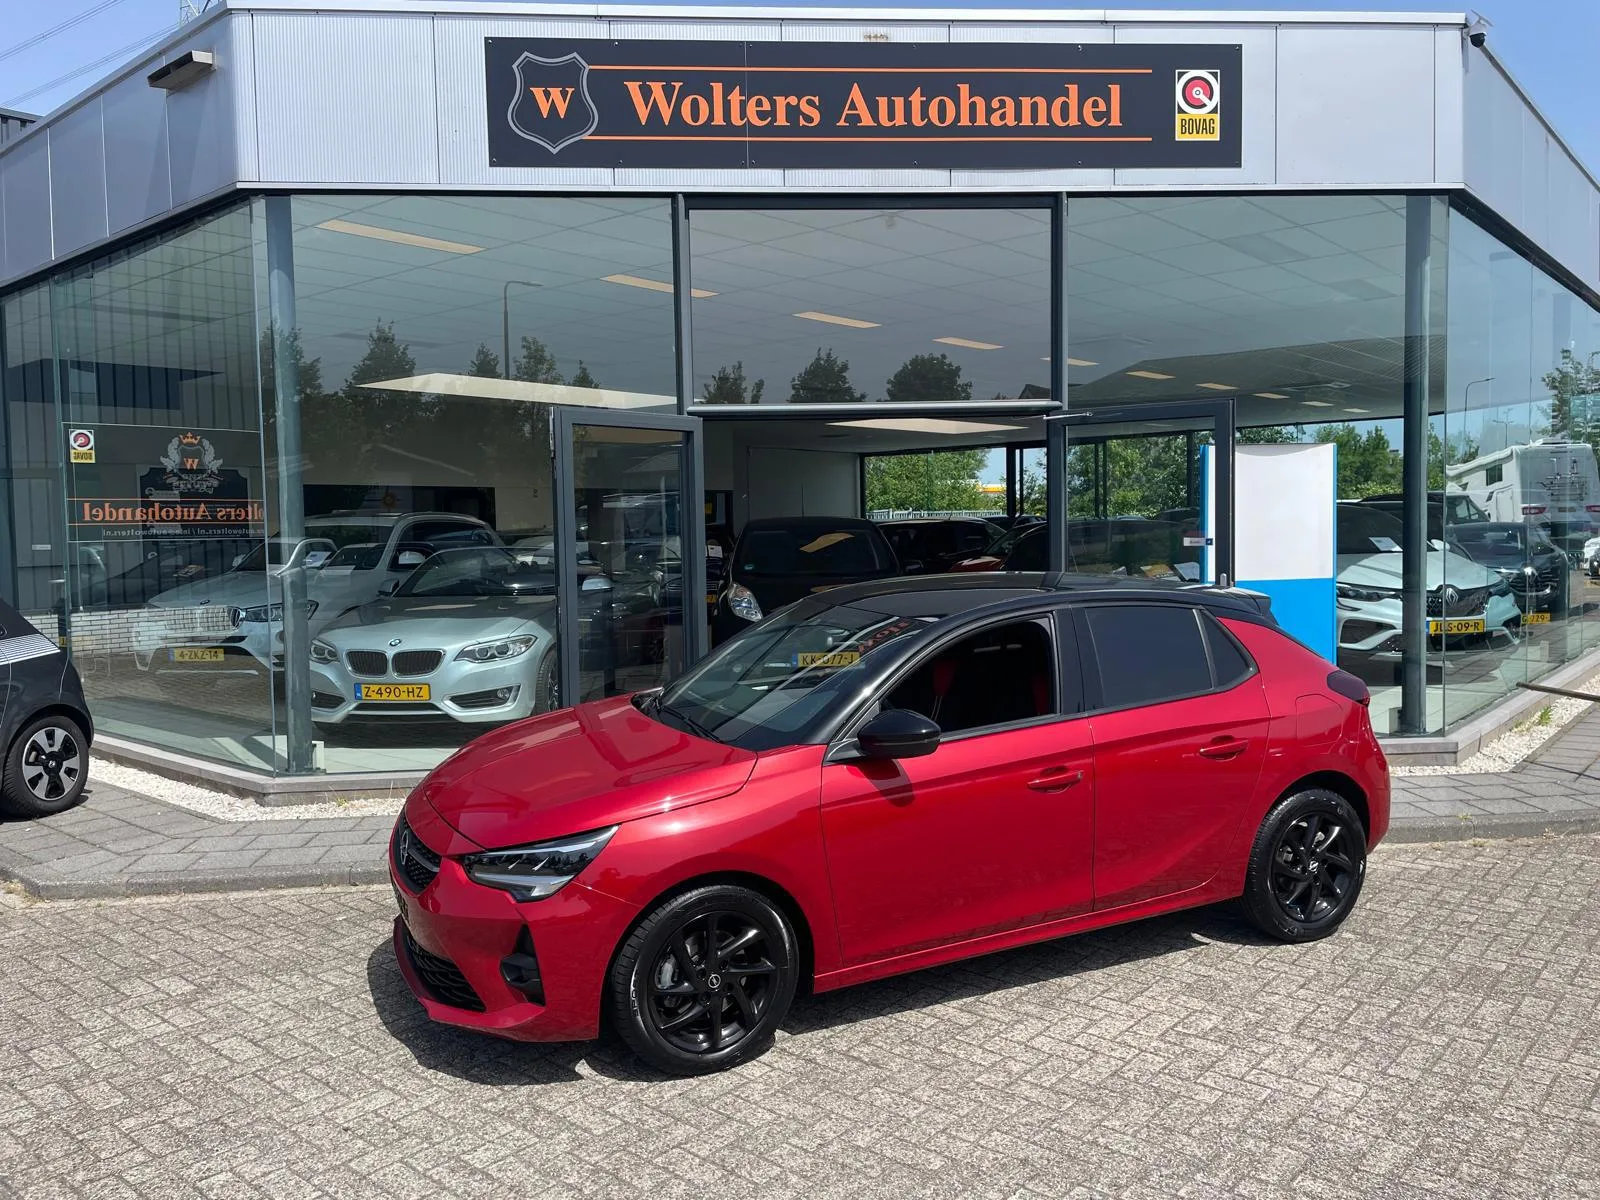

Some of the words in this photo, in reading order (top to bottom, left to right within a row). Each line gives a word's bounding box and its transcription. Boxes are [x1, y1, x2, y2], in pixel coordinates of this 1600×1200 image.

[530, 87, 575, 119] W
[623, 81, 821, 127] Wolters
[836, 82, 1122, 128] Autohandel
[1179, 117, 1216, 136] BOVAG
[364, 686, 424, 698] Z-490-HZ
